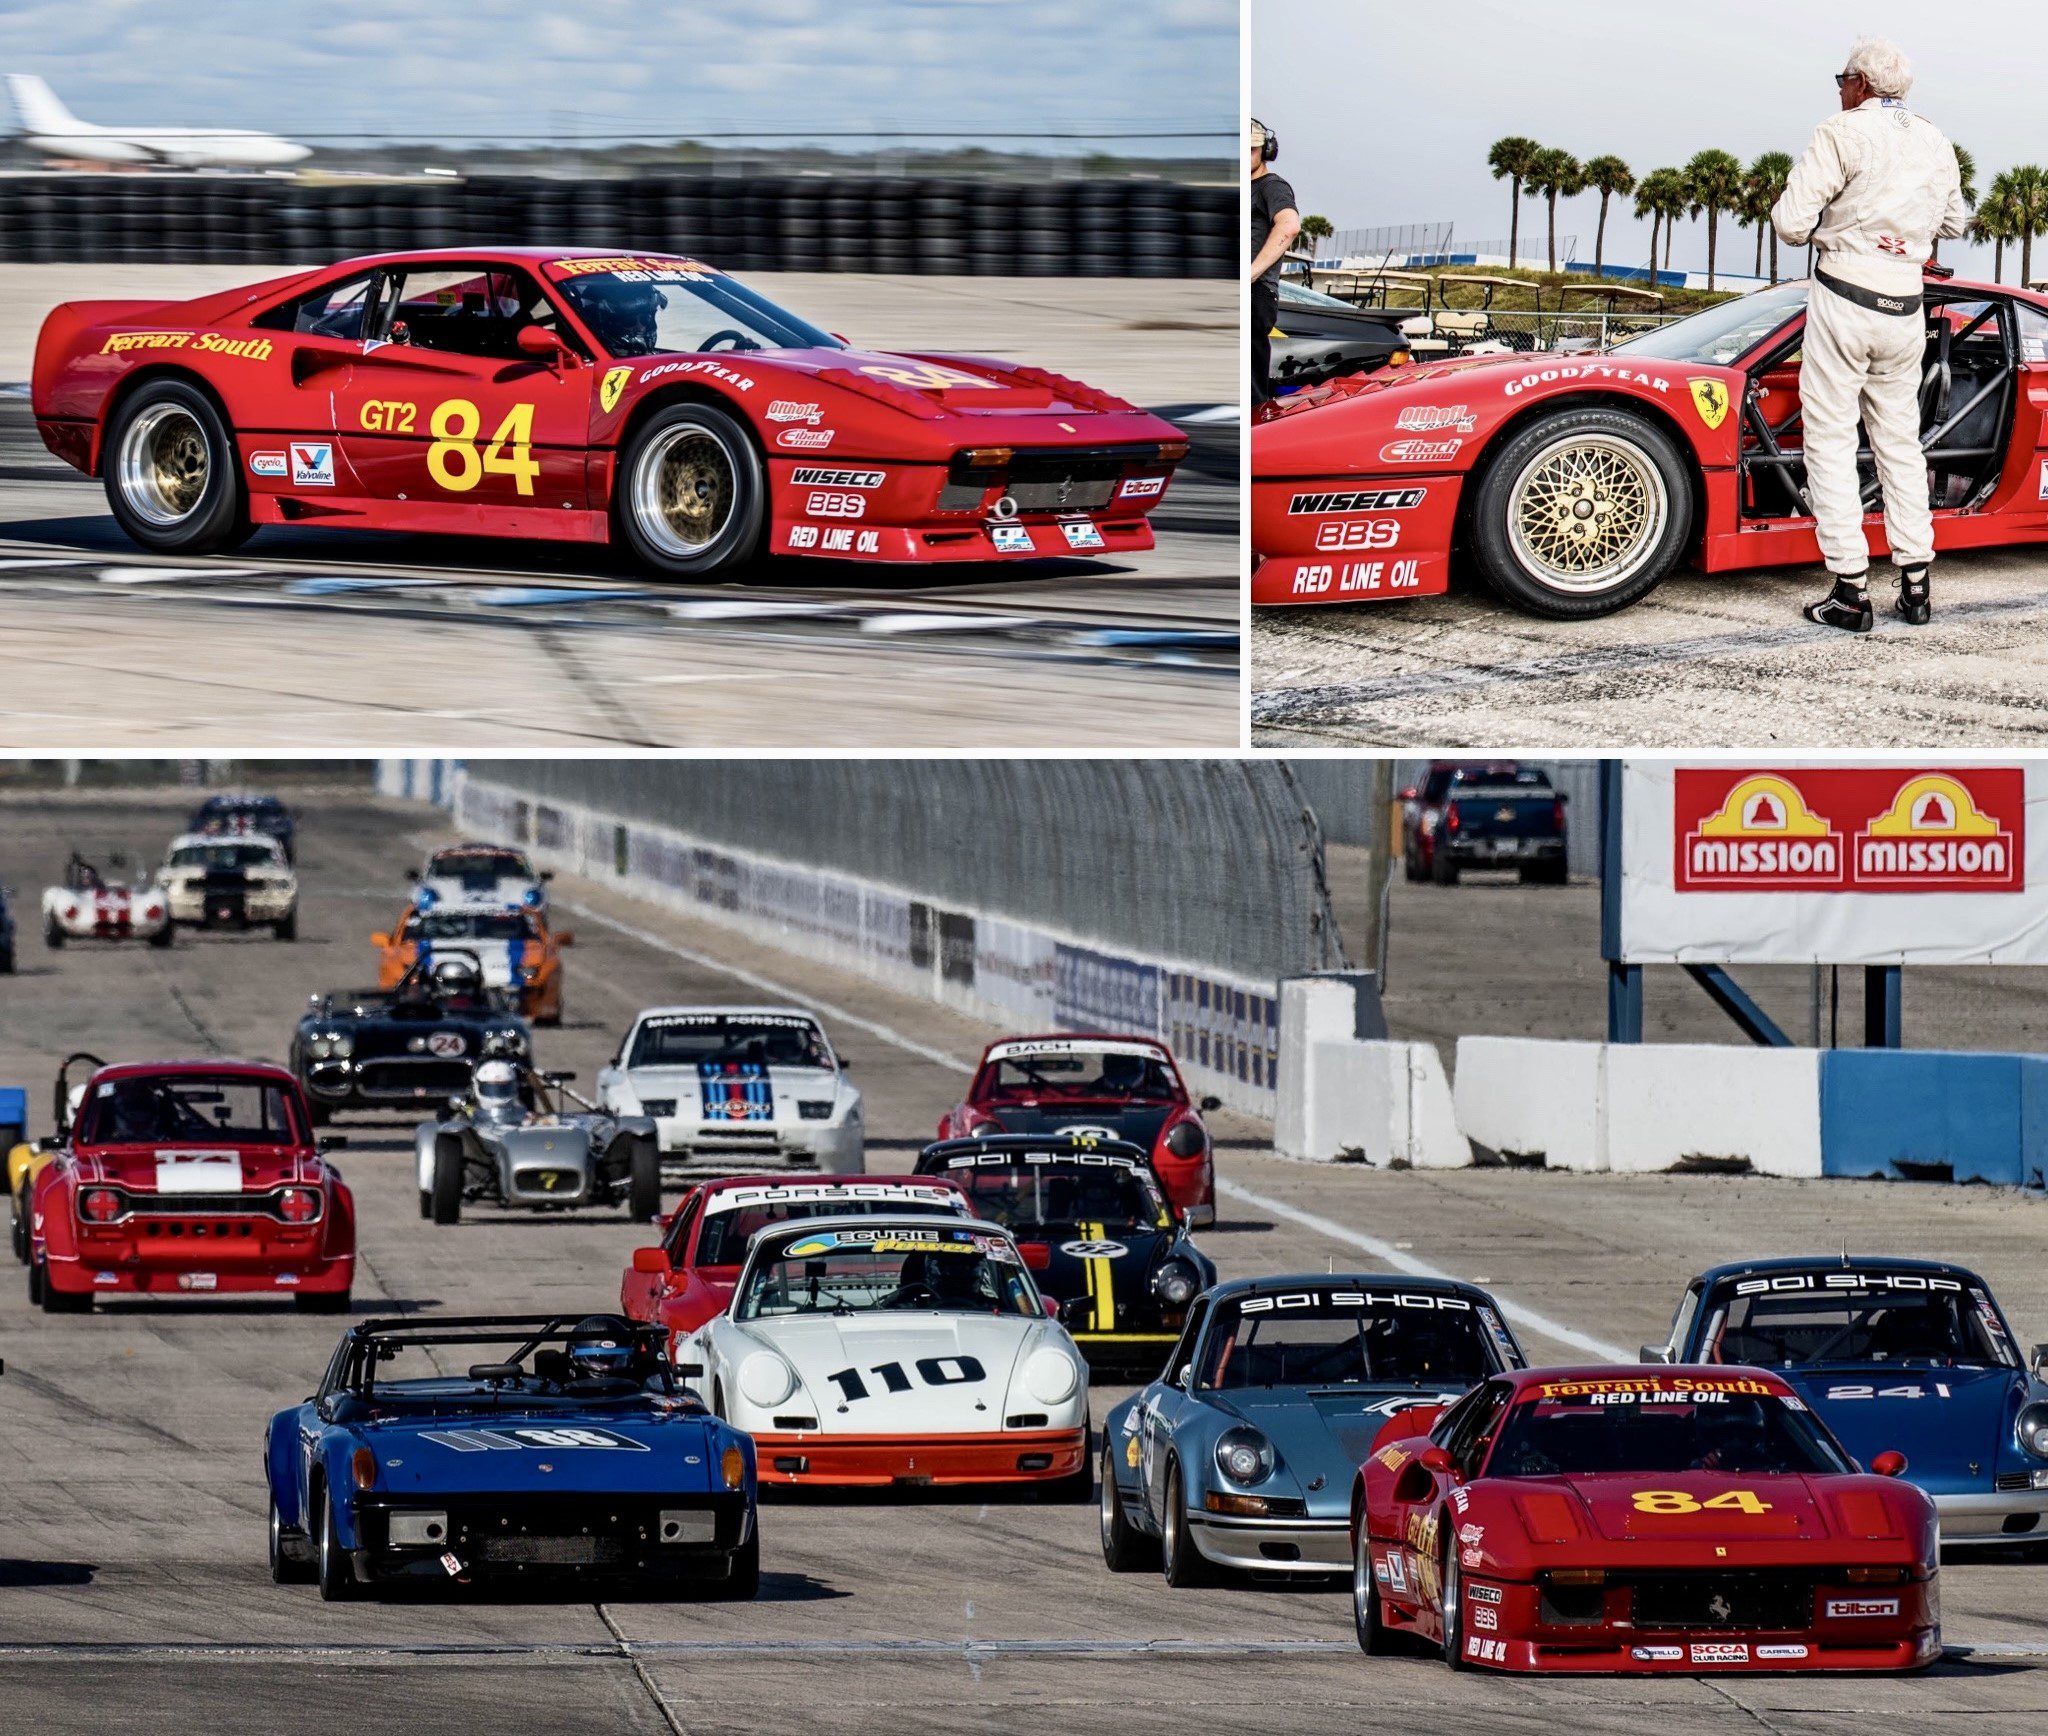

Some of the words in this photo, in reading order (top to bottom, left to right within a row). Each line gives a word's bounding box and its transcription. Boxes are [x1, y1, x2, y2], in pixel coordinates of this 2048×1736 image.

[553, 257, 636, 275] Ferrari
[1925, 328, 1940, 340] CARO
[100, 331, 196, 355] Ferrari
[191, 332, 273, 361] South
[858, 366, 1000, 389] 84
[360, 400, 417, 433] GT2
[768, 400, 818, 416] Olthoff
[1399, 405, 1467, 423] Olthoff
[426, 398, 540, 496] 84
[777, 429, 835, 448] Eibach
[1381, 439, 1462, 462] Eibach
[296, 470, 331, 480] Valvoline
[792, 468, 878, 487] WISECO
[1125, 482, 1160, 494] tilton
[807, 492, 865, 517] BBS
[1290, 489, 1424, 513] WISECO
[788, 526, 818, 549] RED
[821, 528, 855, 551] LINE
[857, 531, 880, 553] OIL
[1316, 519, 1400, 551] BBS
[1292, 565, 1333, 594] RED
[1340, 562, 1385, 591] LINE
[1390, 560, 1419, 588] OIL
[433, 1036, 460, 1052] 24
[1007, 1043, 1071, 1055] BACH
[1025, 1153, 1134, 1168] SHOP
[734, 1187, 939, 1203] PORSCHE
[835, 1230, 939, 1243] ECURIE
[1736, 1276, 1815, 1295] 901
[1825, 1275, 1962, 1292] SHOP
[1240, 1292, 1320, 1314] 901
[1332, 1292, 1471, 1311] SHOP
[827, 1356, 987, 1402] 110
[1540, 1378, 1659, 1398] Ferrari
[1672, 1378, 1772, 1396] South
[1590, 1392, 1636, 1405] RED
[1639, 1391, 1690, 1404] LINE
[1692, 1391, 1730, 1403] OIL
[1826, 1383, 1951, 1400] 241
[514, 1430, 619, 1446] 88
[1631, 1491, 1773, 1514] 84
[1469, 1585, 1500, 1602] WISECO
[1831, 1602, 1894, 1615] tilton
[1692, 1645, 1747, 1654] SCCA
